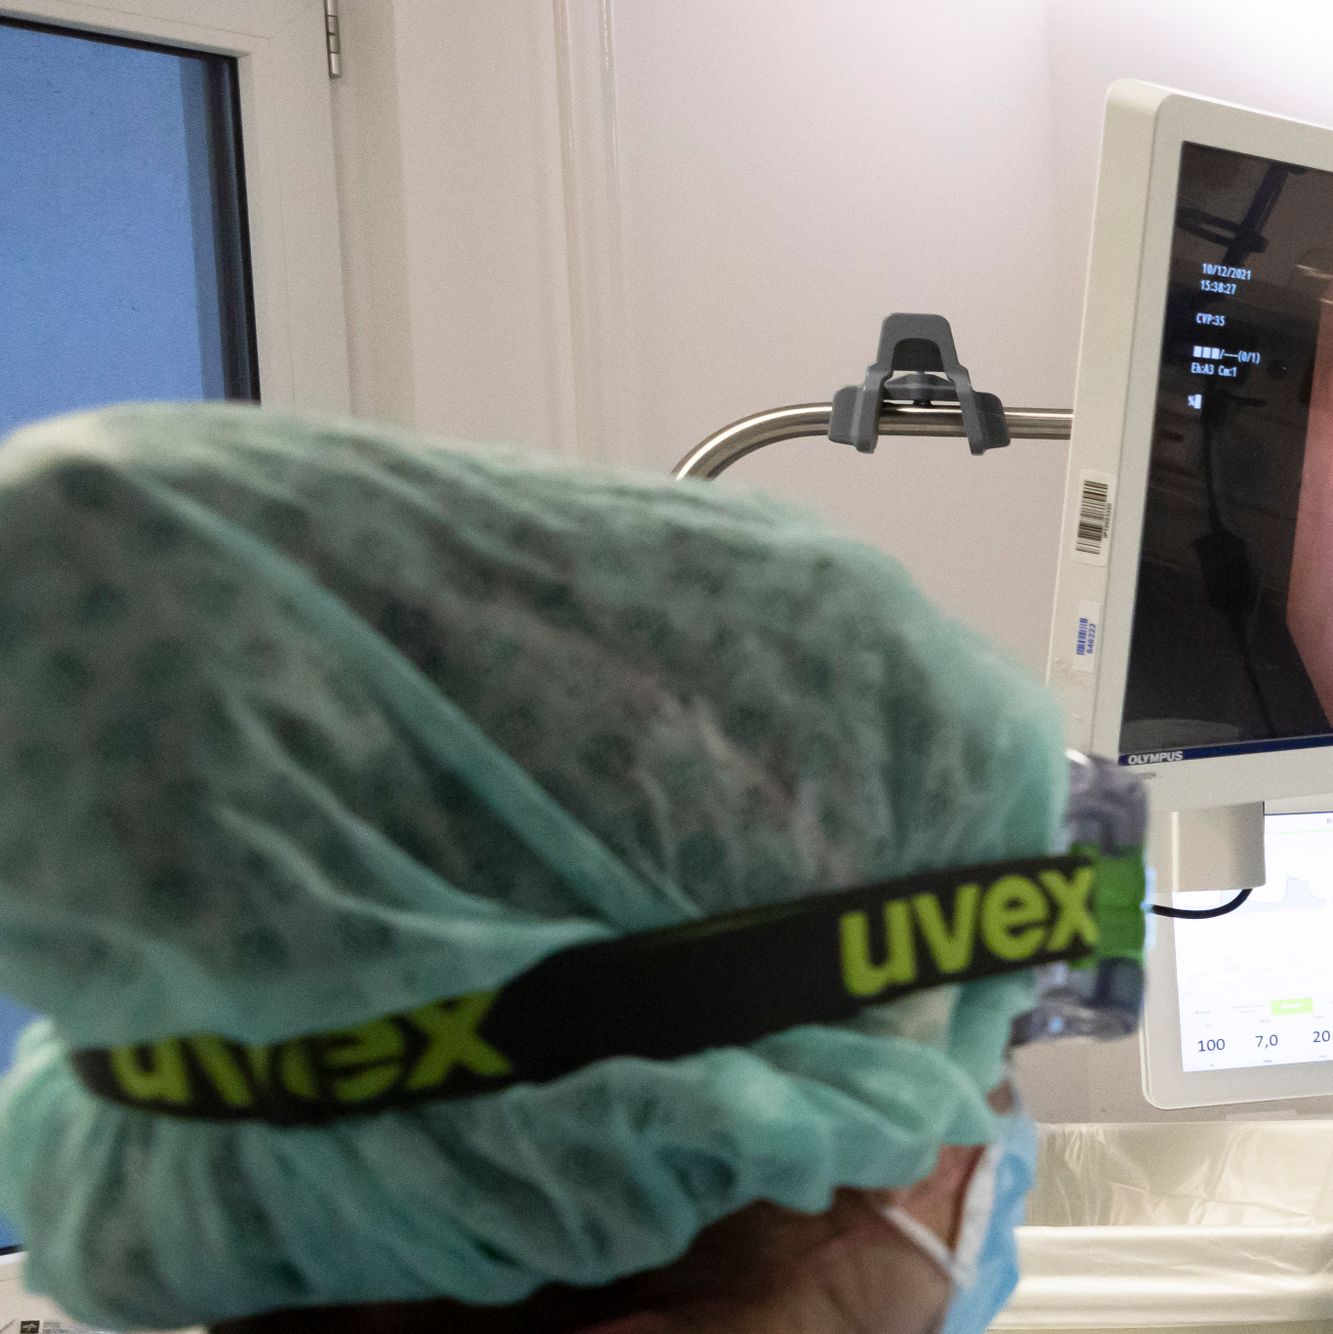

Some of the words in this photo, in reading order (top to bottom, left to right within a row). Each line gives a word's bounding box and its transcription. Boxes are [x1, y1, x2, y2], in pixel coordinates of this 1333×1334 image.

[1202, 263, 1252, 280] 10/12/2021
[1200, 280, 1236, 295] 15:38:27
[1128, 751, 1183, 765] OLYMPUS
[839, 867, 1098, 997] uvex
[1197, 1038, 1226, 1053] 100
[1255, 1034, 1279, 1049] 7,0
[1312, 1030, 1331, 1043] 20
